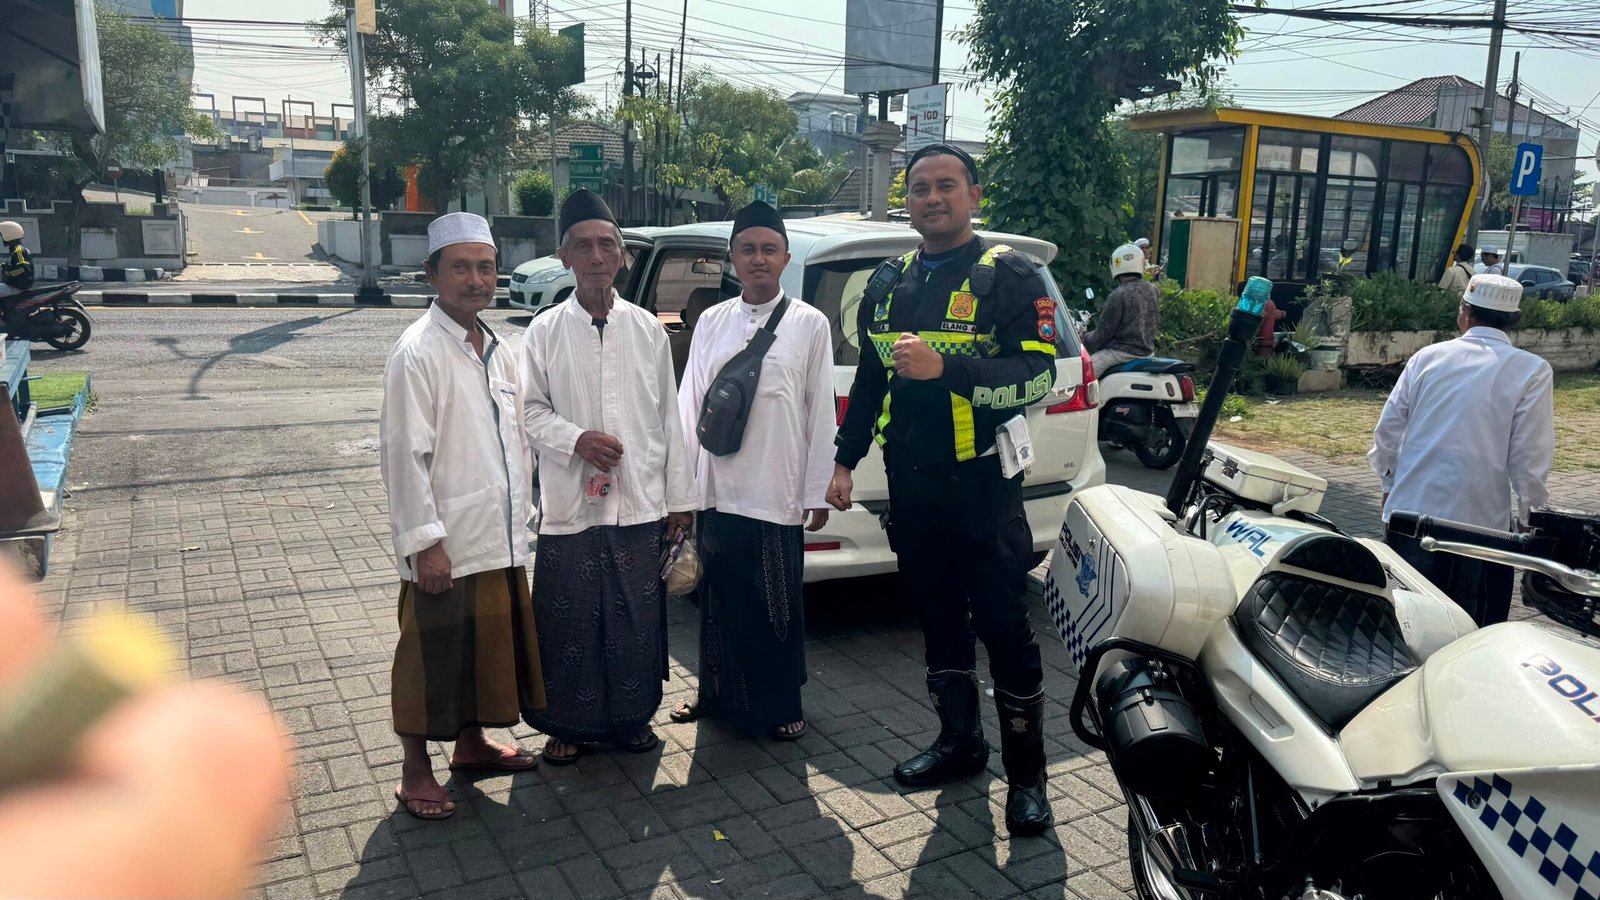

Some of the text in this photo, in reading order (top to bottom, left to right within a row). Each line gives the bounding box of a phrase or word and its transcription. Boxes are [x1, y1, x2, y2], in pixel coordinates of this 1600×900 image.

[924, 111, 938, 120] IGD
[1517, 151, 1536, 188] P
[972, 369, 1052, 410] POLISI
[1060, 520, 1083, 562] POLISI
